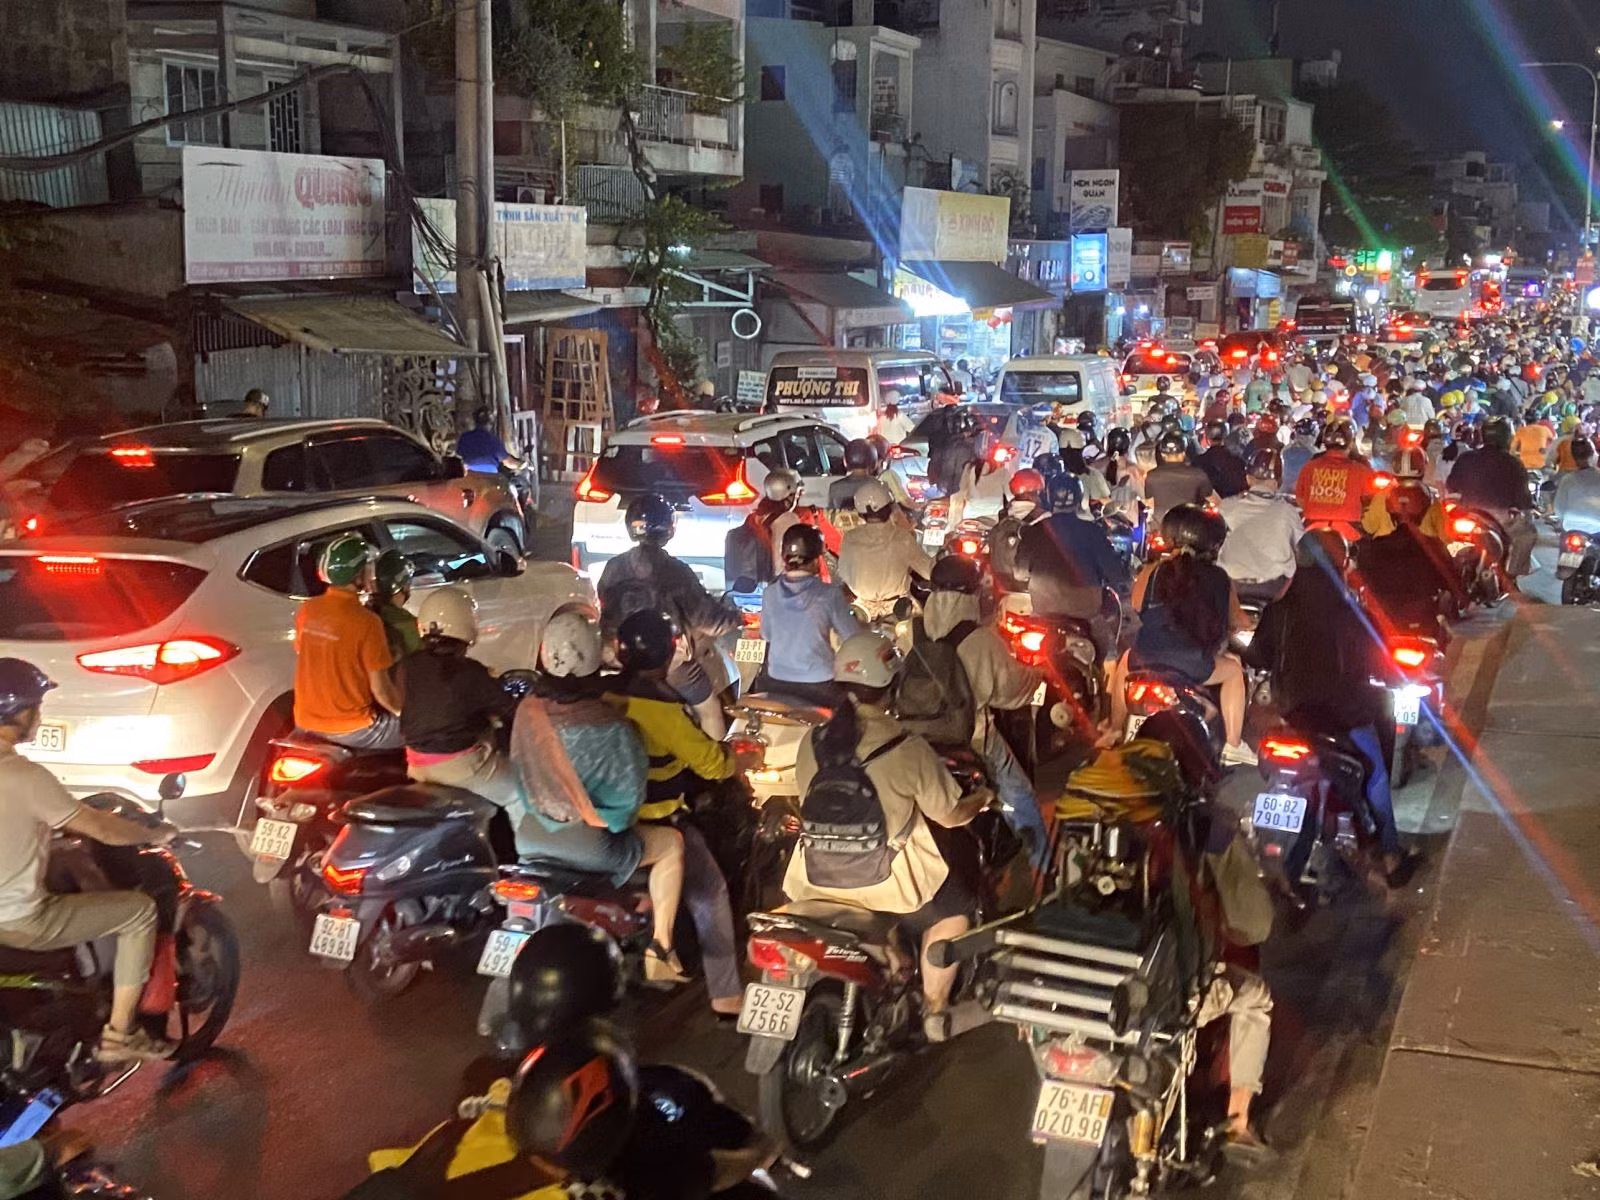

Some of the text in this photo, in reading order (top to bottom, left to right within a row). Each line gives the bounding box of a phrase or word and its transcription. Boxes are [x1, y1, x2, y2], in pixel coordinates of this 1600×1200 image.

[1025, 438, 1042, 458] 17
[747, 1009, 790, 1033] 7566
[1036, 1108, 1103, 1140] 020.98
